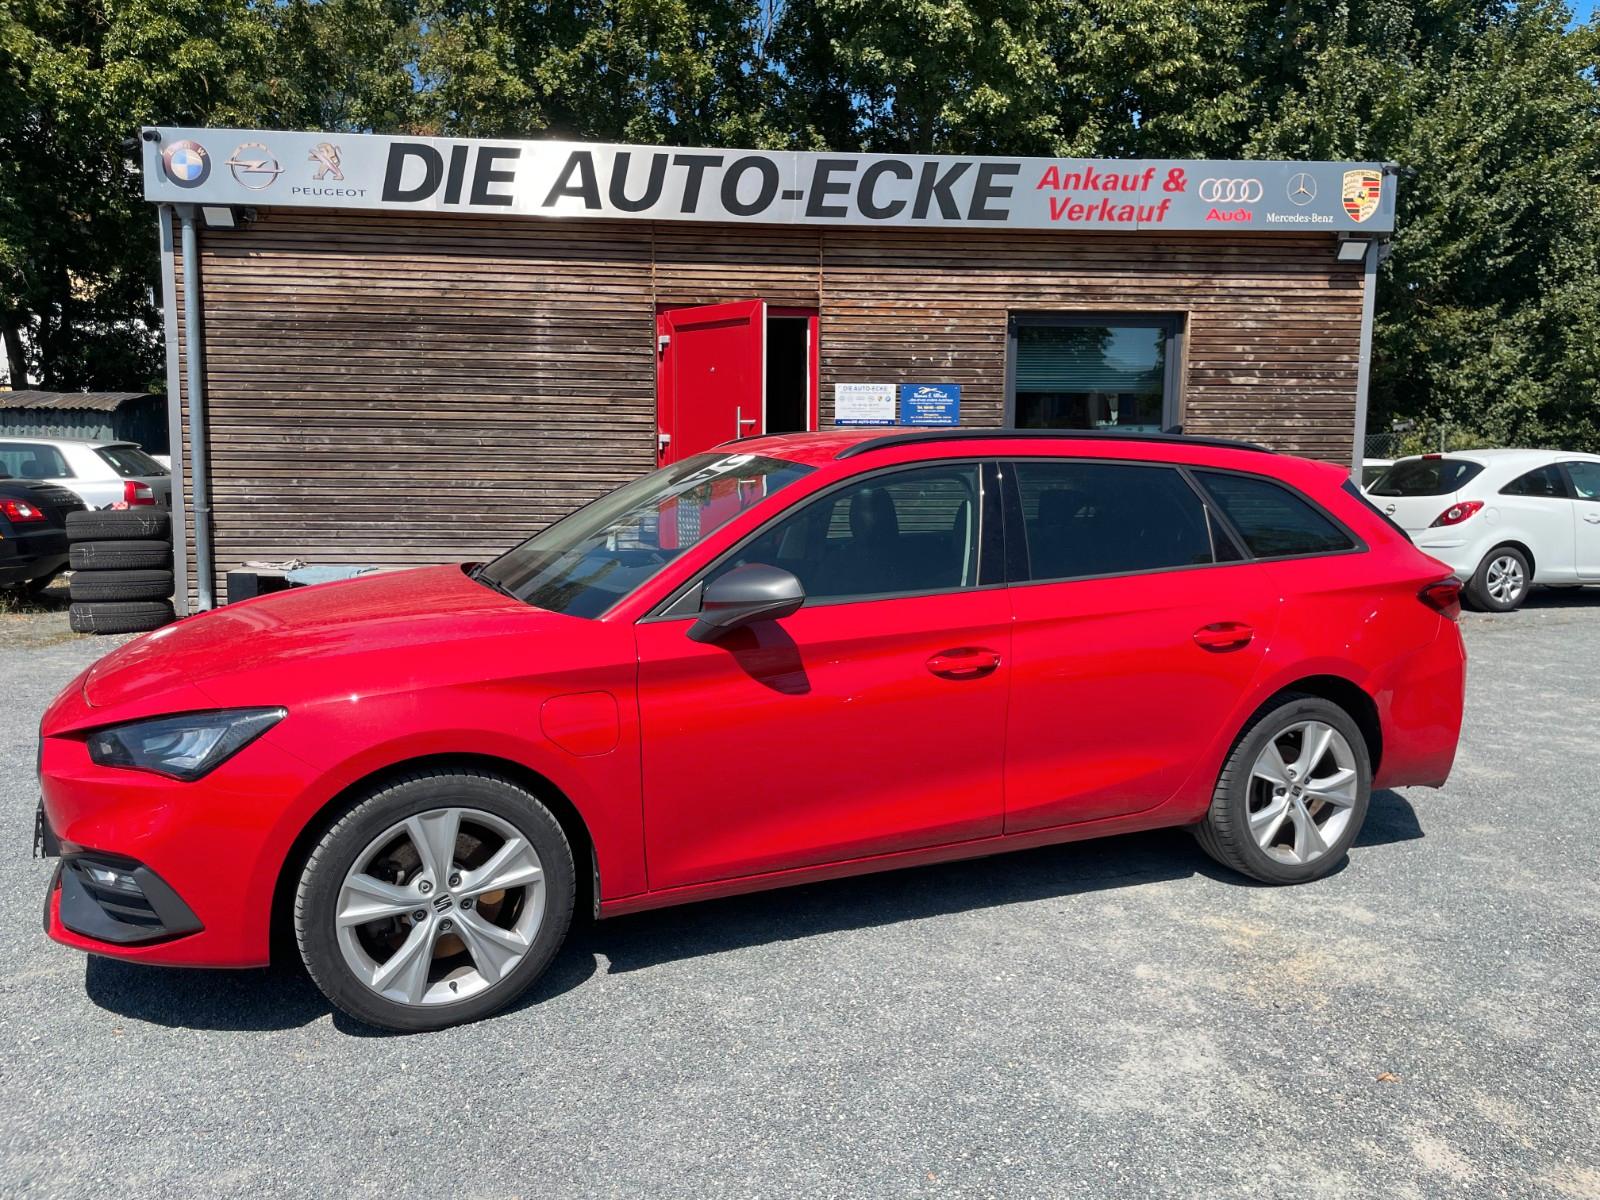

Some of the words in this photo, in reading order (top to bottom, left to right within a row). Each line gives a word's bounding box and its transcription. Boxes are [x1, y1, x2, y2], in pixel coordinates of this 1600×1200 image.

[381, 142, 522, 207] DIE
[541, 150, 1021, 221] AUTO-ECKE
[1036, 165, 1156, 192] Ankauf
[1162, 167, 1188, 193] &
[291, 186, 368, 198] PEUGEOT
[1048, 196, 1171, 223] Verkauf
[1205, 207, 1252, 222] Audi
[1266, 212, 1333, 224] Mercedes-Benz
